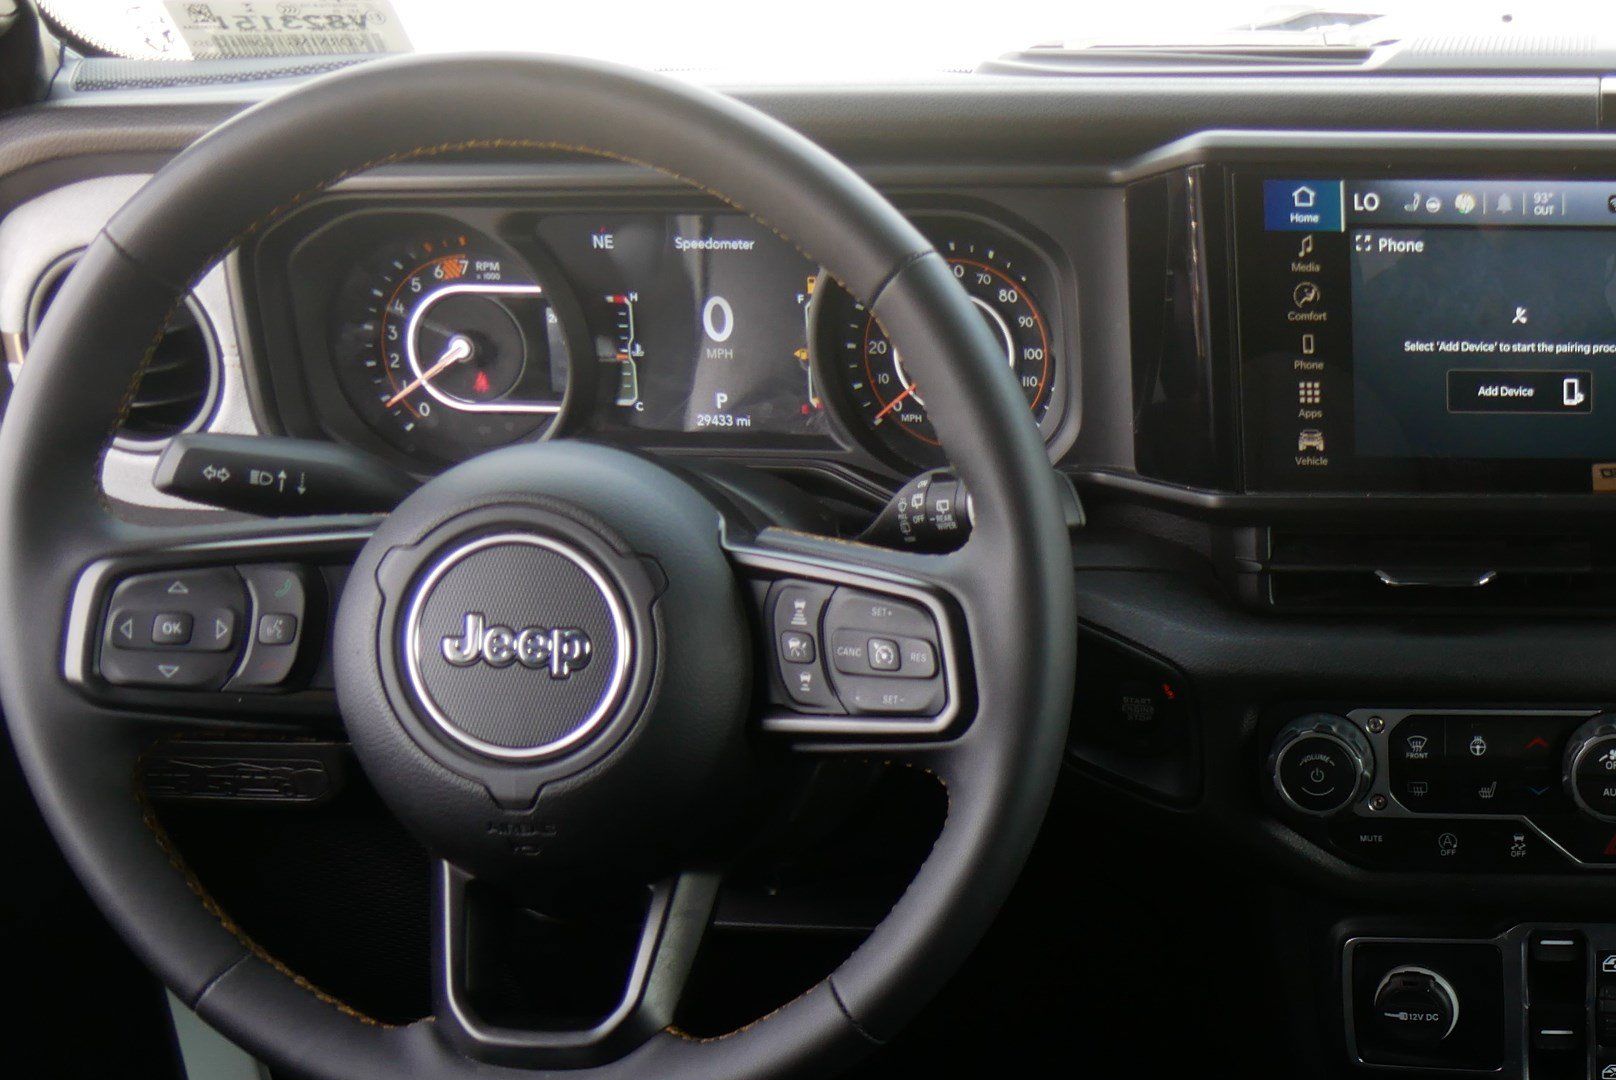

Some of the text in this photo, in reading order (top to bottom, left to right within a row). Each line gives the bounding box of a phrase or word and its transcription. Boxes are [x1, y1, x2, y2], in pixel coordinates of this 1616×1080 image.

[1353, 193, 1380, 212] LO
[1533, 205, 1555, 216] OUT
[1290, 212, 1320, 223] Home
[592, 234, 615, 249] NE
[675, 236, 755, 252] Speedometer
[1378, 238, 1424, 253] Phone
[434, 265, 444, 279] 6
[459, 260, 470, 275] 7
[475, 261, 501, 272] RPM
[1291, 262, 1321, 272] Media
[411, 278, 422, 292] 5
[977, 273, 992, 285] 70
[999, 289, 1018, 303] 80
[394, 301, 405, 313] 4
[703, 295, 734, 342] 0
[1287, 311, 1327, 321] Comfort
[1019, 316, 1033, 329] 90
[387, 325, 398, 341] 3
[868, 341, 887, 354] 20
[1404, 341, 1435, 352] Select
[1499, 342, 1511, 353] to
[1512, 342, 1536, 353] start
[1537, 342, 1554, 353] the
[1555, 342, 1591, 356] pairing
[390, 353, 400, 368] 2
[706, 349, 734, 360] MPH
[1023, 349, 1043, 360] 100
[1294, 360, 1324, 370] Phone
[878, 373, 890, 384] 10
[1022, 375, 1038, 388] 110
[1478, 386, 1534, 397] Add Device
[716, 392, 729, 409] P
[419, 403, 430, 417] 0
[1297, 408, 1323, 420] Apps
[697, 414, 751, 427] 29433 mi
[901, 413, 922, 423] MPH
[1295, 456, 1329, 467] Vehicle
[162, 621, 182, 635] OK
[441, 611, 594, 680] Jeep
[836, 648, 862, 658] CANC
[910, 653, 927, 663] RES
[1302, 753, 1332, 764] VOLUME
[1405, 751, 1429, 760] FRONT
[1360, 834, 1384, 843] MUTE
[1440, 849, 1457, 857] OFF
[1510, 850, 1526, 858] OFF
[1409, 1013, 1439, 1021] 12V DC
